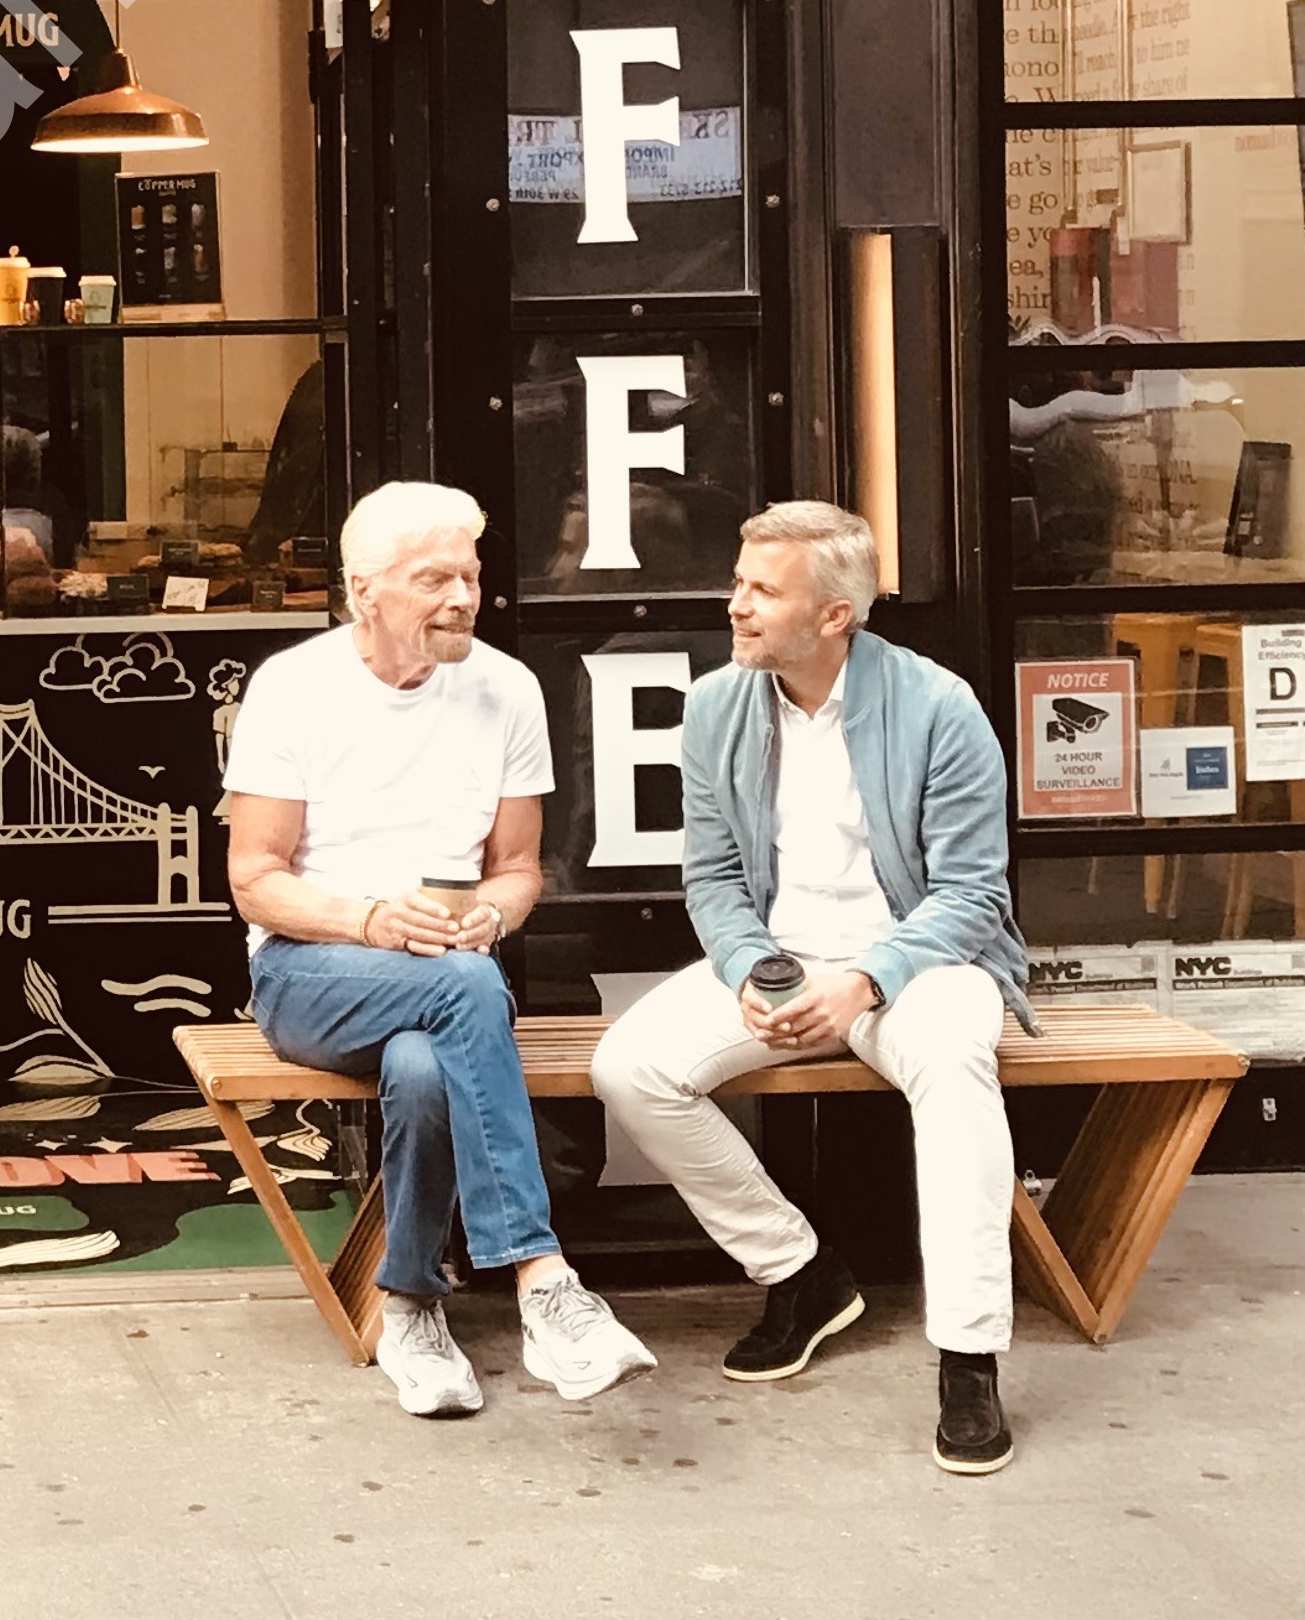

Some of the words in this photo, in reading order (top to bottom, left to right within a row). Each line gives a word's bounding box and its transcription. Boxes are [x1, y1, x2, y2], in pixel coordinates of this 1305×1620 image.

[1047, 671, 1110, 689] NOTICE
[1269, 667, 1297, 701] D
[1054, 753, 1068, 763] 24
[1070, 751, 1102, 763] HOUR
[1061, 765, 1096, 776] VIDEO
[1036, 777, 1121, 790] SURVEILLANCE
[1028, 960, 1084, 981] NYC
[1175, 956, 1232, 977] NYC
